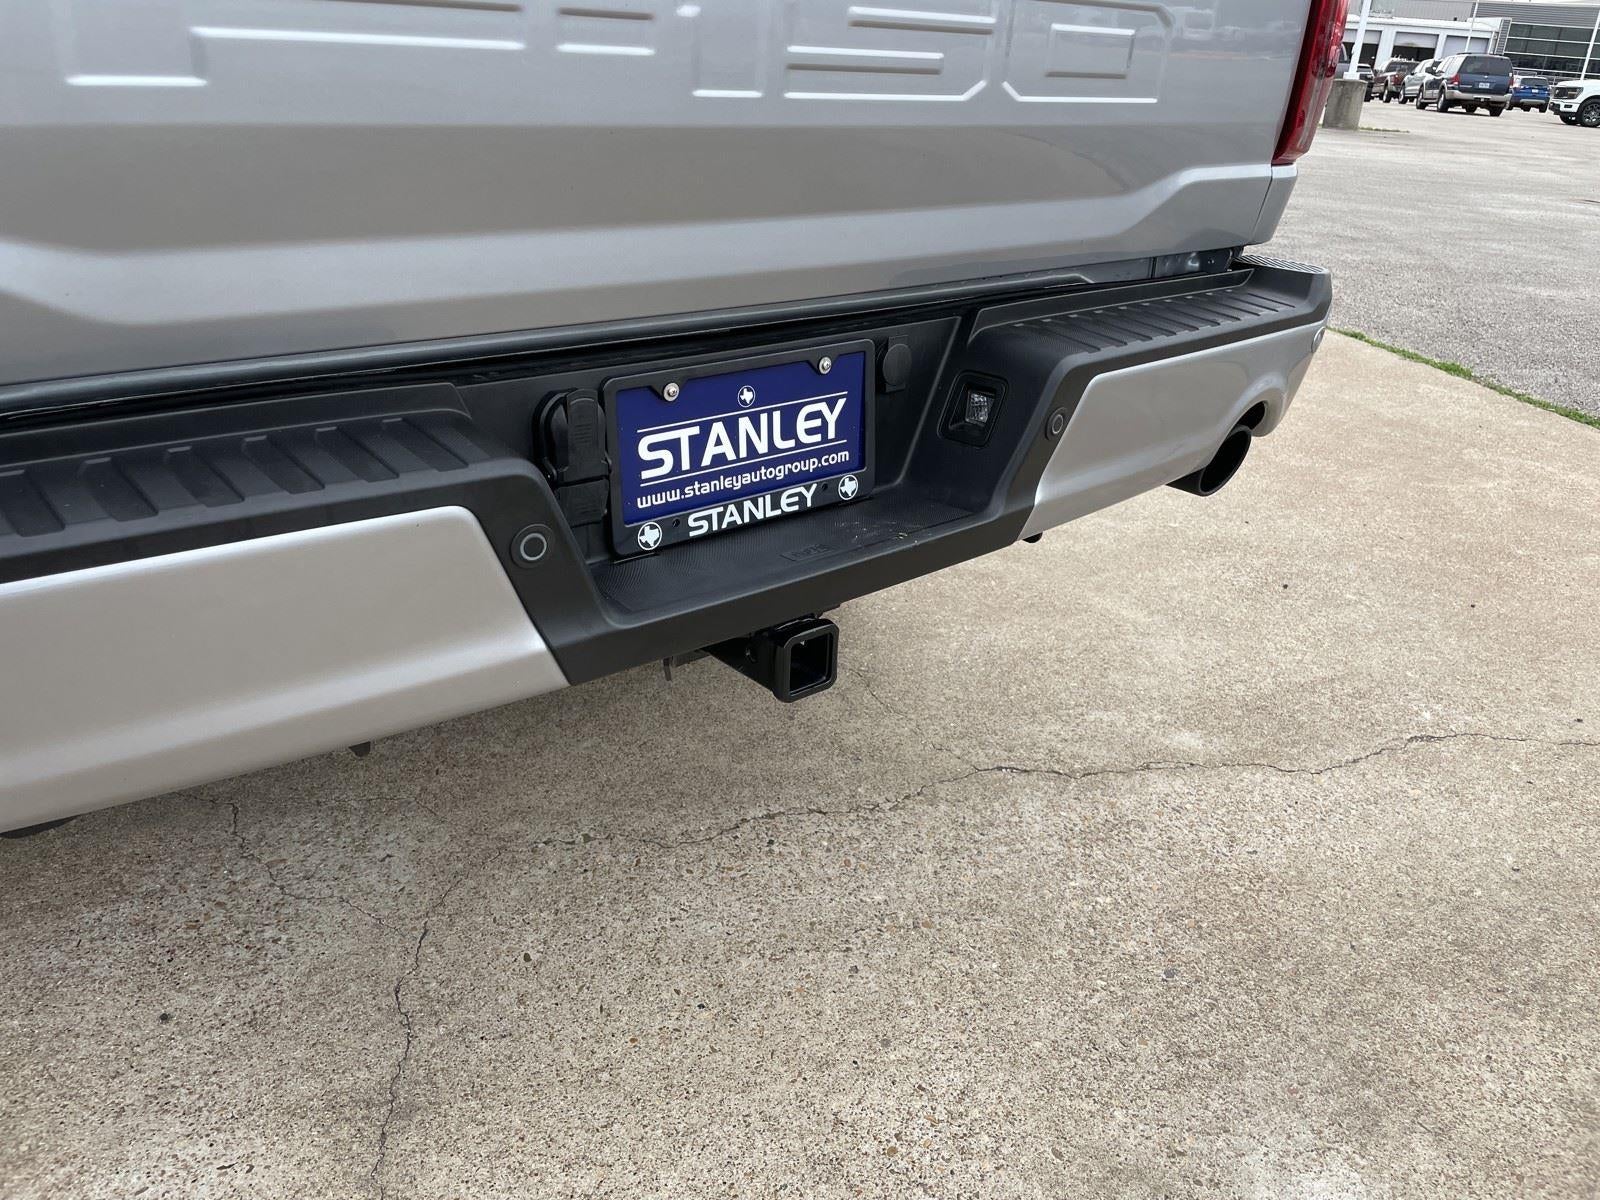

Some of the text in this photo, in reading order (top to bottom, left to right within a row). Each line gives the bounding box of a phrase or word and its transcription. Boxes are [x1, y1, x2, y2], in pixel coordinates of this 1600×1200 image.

[637, 397, 847, 480] STANLEY
[636, 450, 850, 509] www.stanleyautogroup.com
[687, 483, 818, 537] STANLEY
